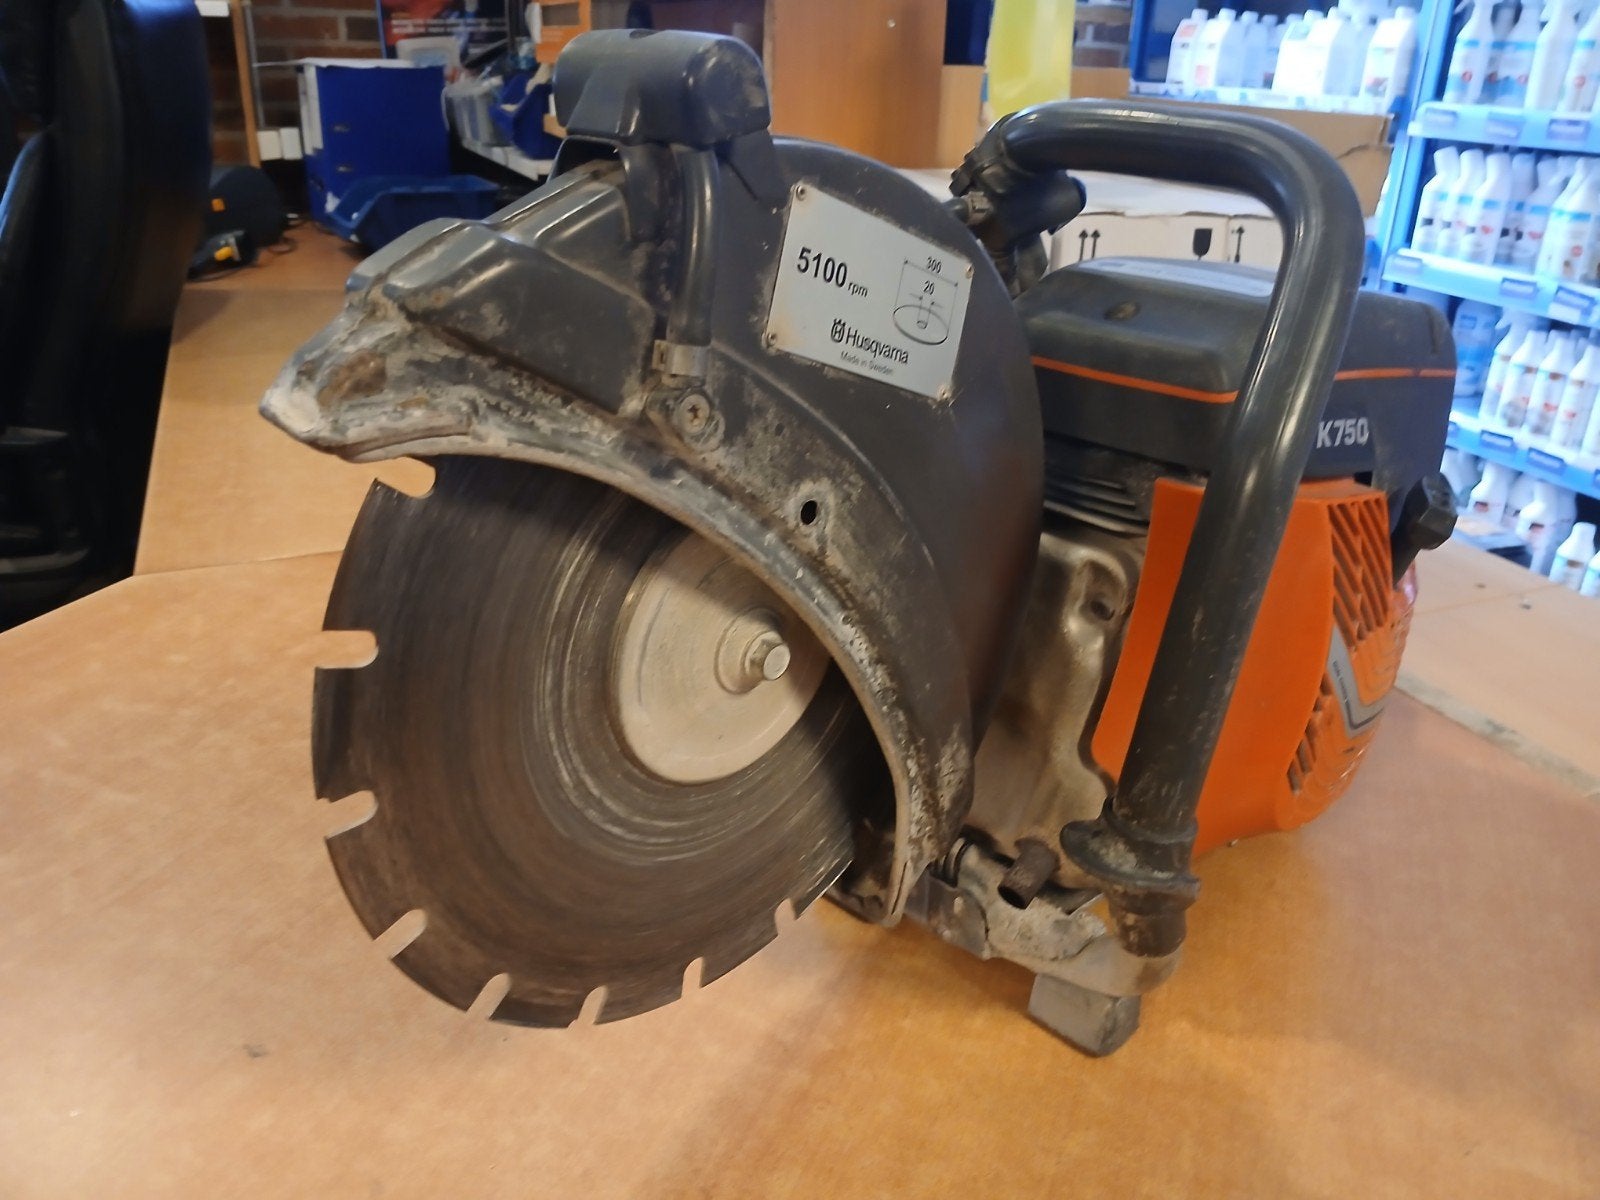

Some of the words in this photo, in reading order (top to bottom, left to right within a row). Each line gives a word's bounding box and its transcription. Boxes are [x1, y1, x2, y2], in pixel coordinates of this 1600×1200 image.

[797, 246, 848, 288] 5100
[847, 282, 868, 298] rpm
[927, 256, 942, 274] 300
[845, 327, 909, 364] Husqvarna
[1316, 417, 1370, 449] K750
